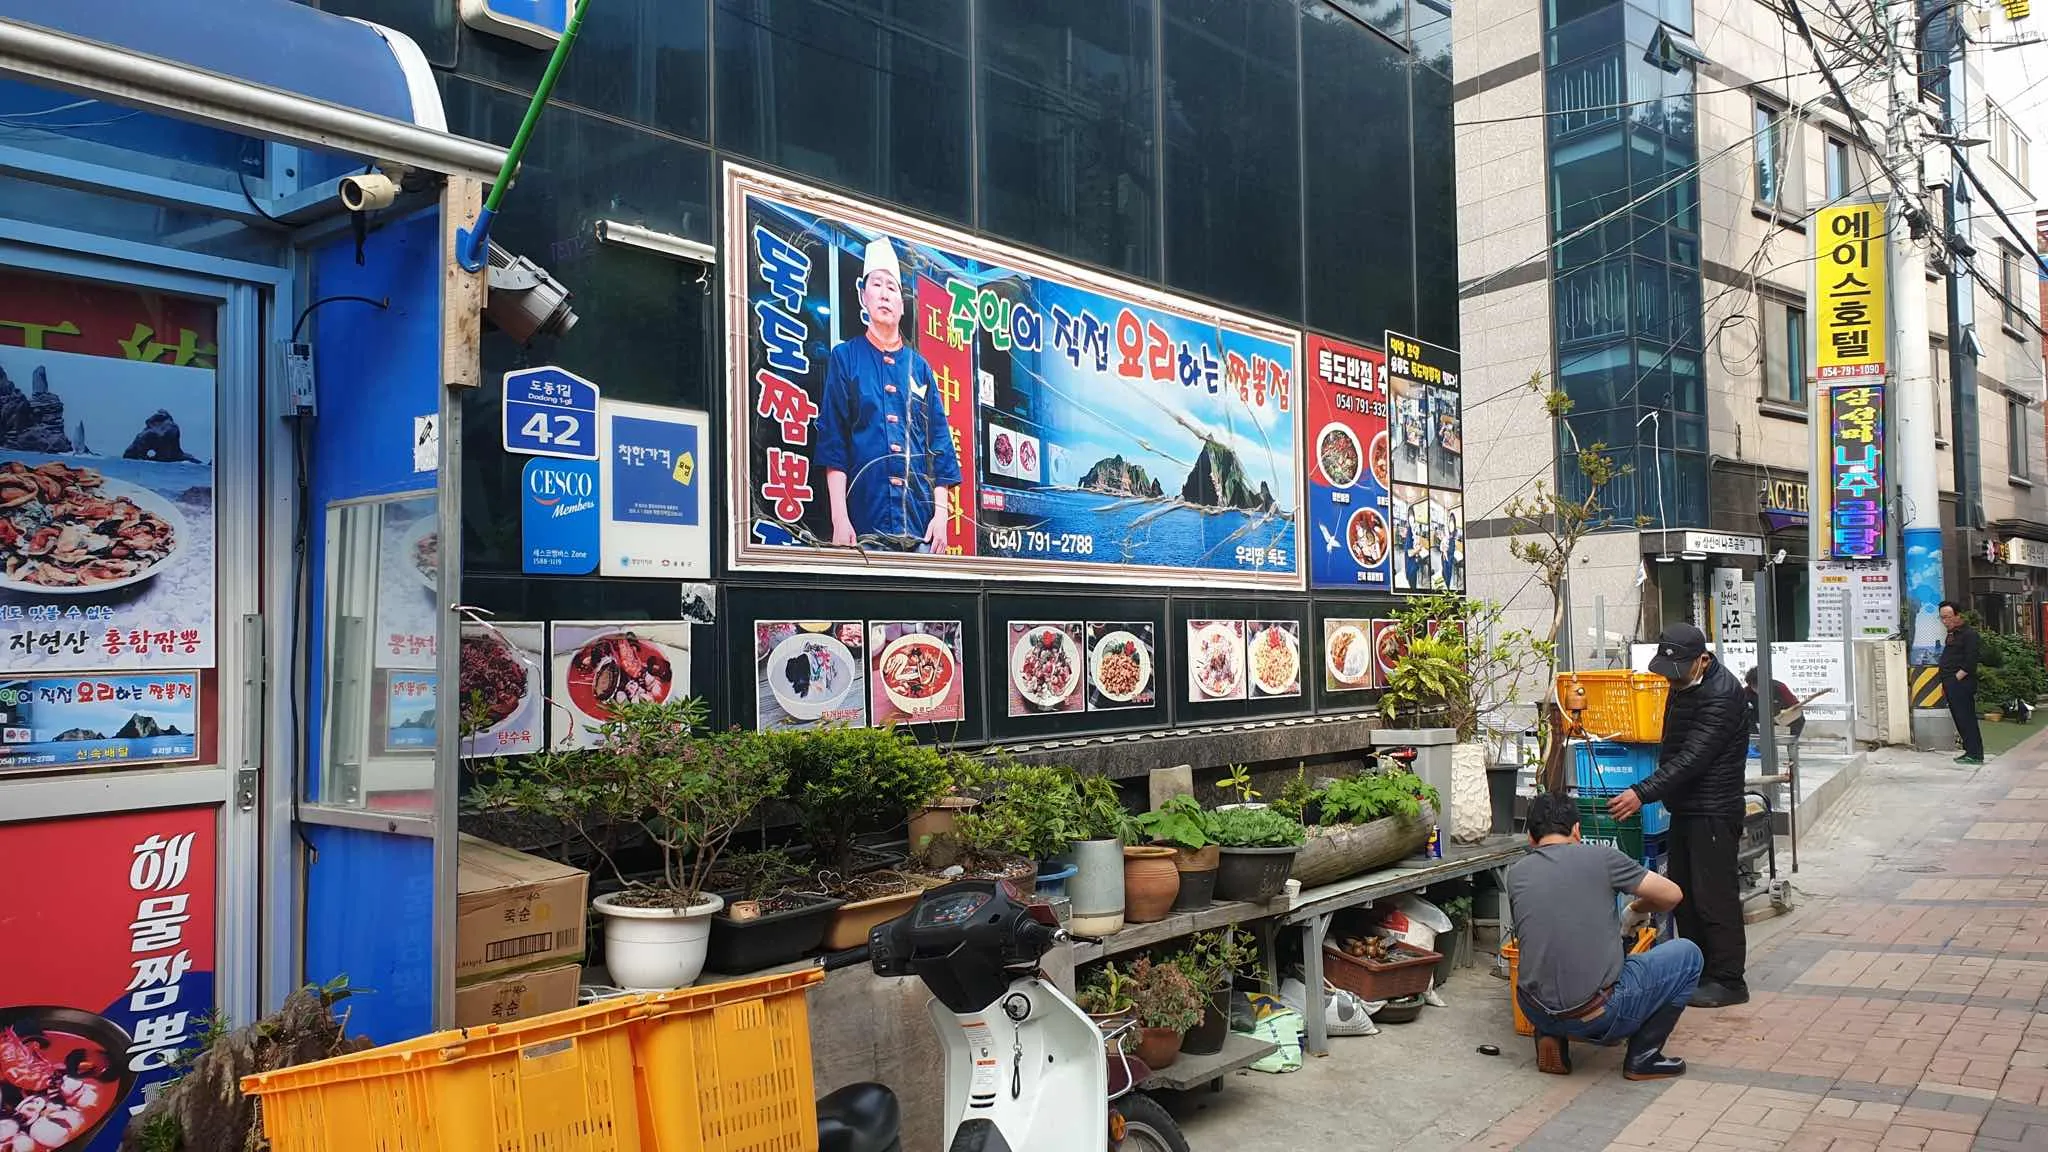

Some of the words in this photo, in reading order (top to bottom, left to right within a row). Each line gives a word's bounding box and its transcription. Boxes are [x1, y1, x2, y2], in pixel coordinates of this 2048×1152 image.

[1829, 211, 1871, 358] 에이스호텔
[1050, 306, 1110, 371] 직접
[1115, 308, 1219, 395] 요리하는
[1226, 350, 1292, 412] 짬뽕점
[1319, 350, 1374, 392] 독도반점
[1822, 364, 1880, 378] 054-791-1090
[528, 393, 558, 403] Dodong
[529, 380, 572, 398] 도동1길
[1336, 393, 1353, 411] 054)
[520, 412, 581, 447] 42
[618, 443, 671, 470] 착한가격
[530, 468, 593, 498] CESCO
[1767, 480, 1794, 511] ACE
[551, 498, 595, 519] Members
[1027, 531, 1093, 555] 791-2788
[1235, 545, 1264, 565] 우리땅
[1266, 547, 1287, 566] 독도
[29, 605, 60, 622] 맛볼
[65, 606, 81, 619] 수
[86, 606, 115, 622] 없는
[10, 631, 91, 655] 자연산
[102, 629, 202, 655] 홍합짬뽕
[40, 687, 73, 705] 직접
[77, 682, 143, 704] 요리하는
[149, 683, 193, 700] 짬뽕점
[496, 730, 532, 745] 탕수육
[77, 746, 129, 760] 신속배달
[503, 907, 531, 924] 죽순
[126, 832, 197, 1072] 해물짬뽕
[491, 1000, 519, 1018] 죽순
